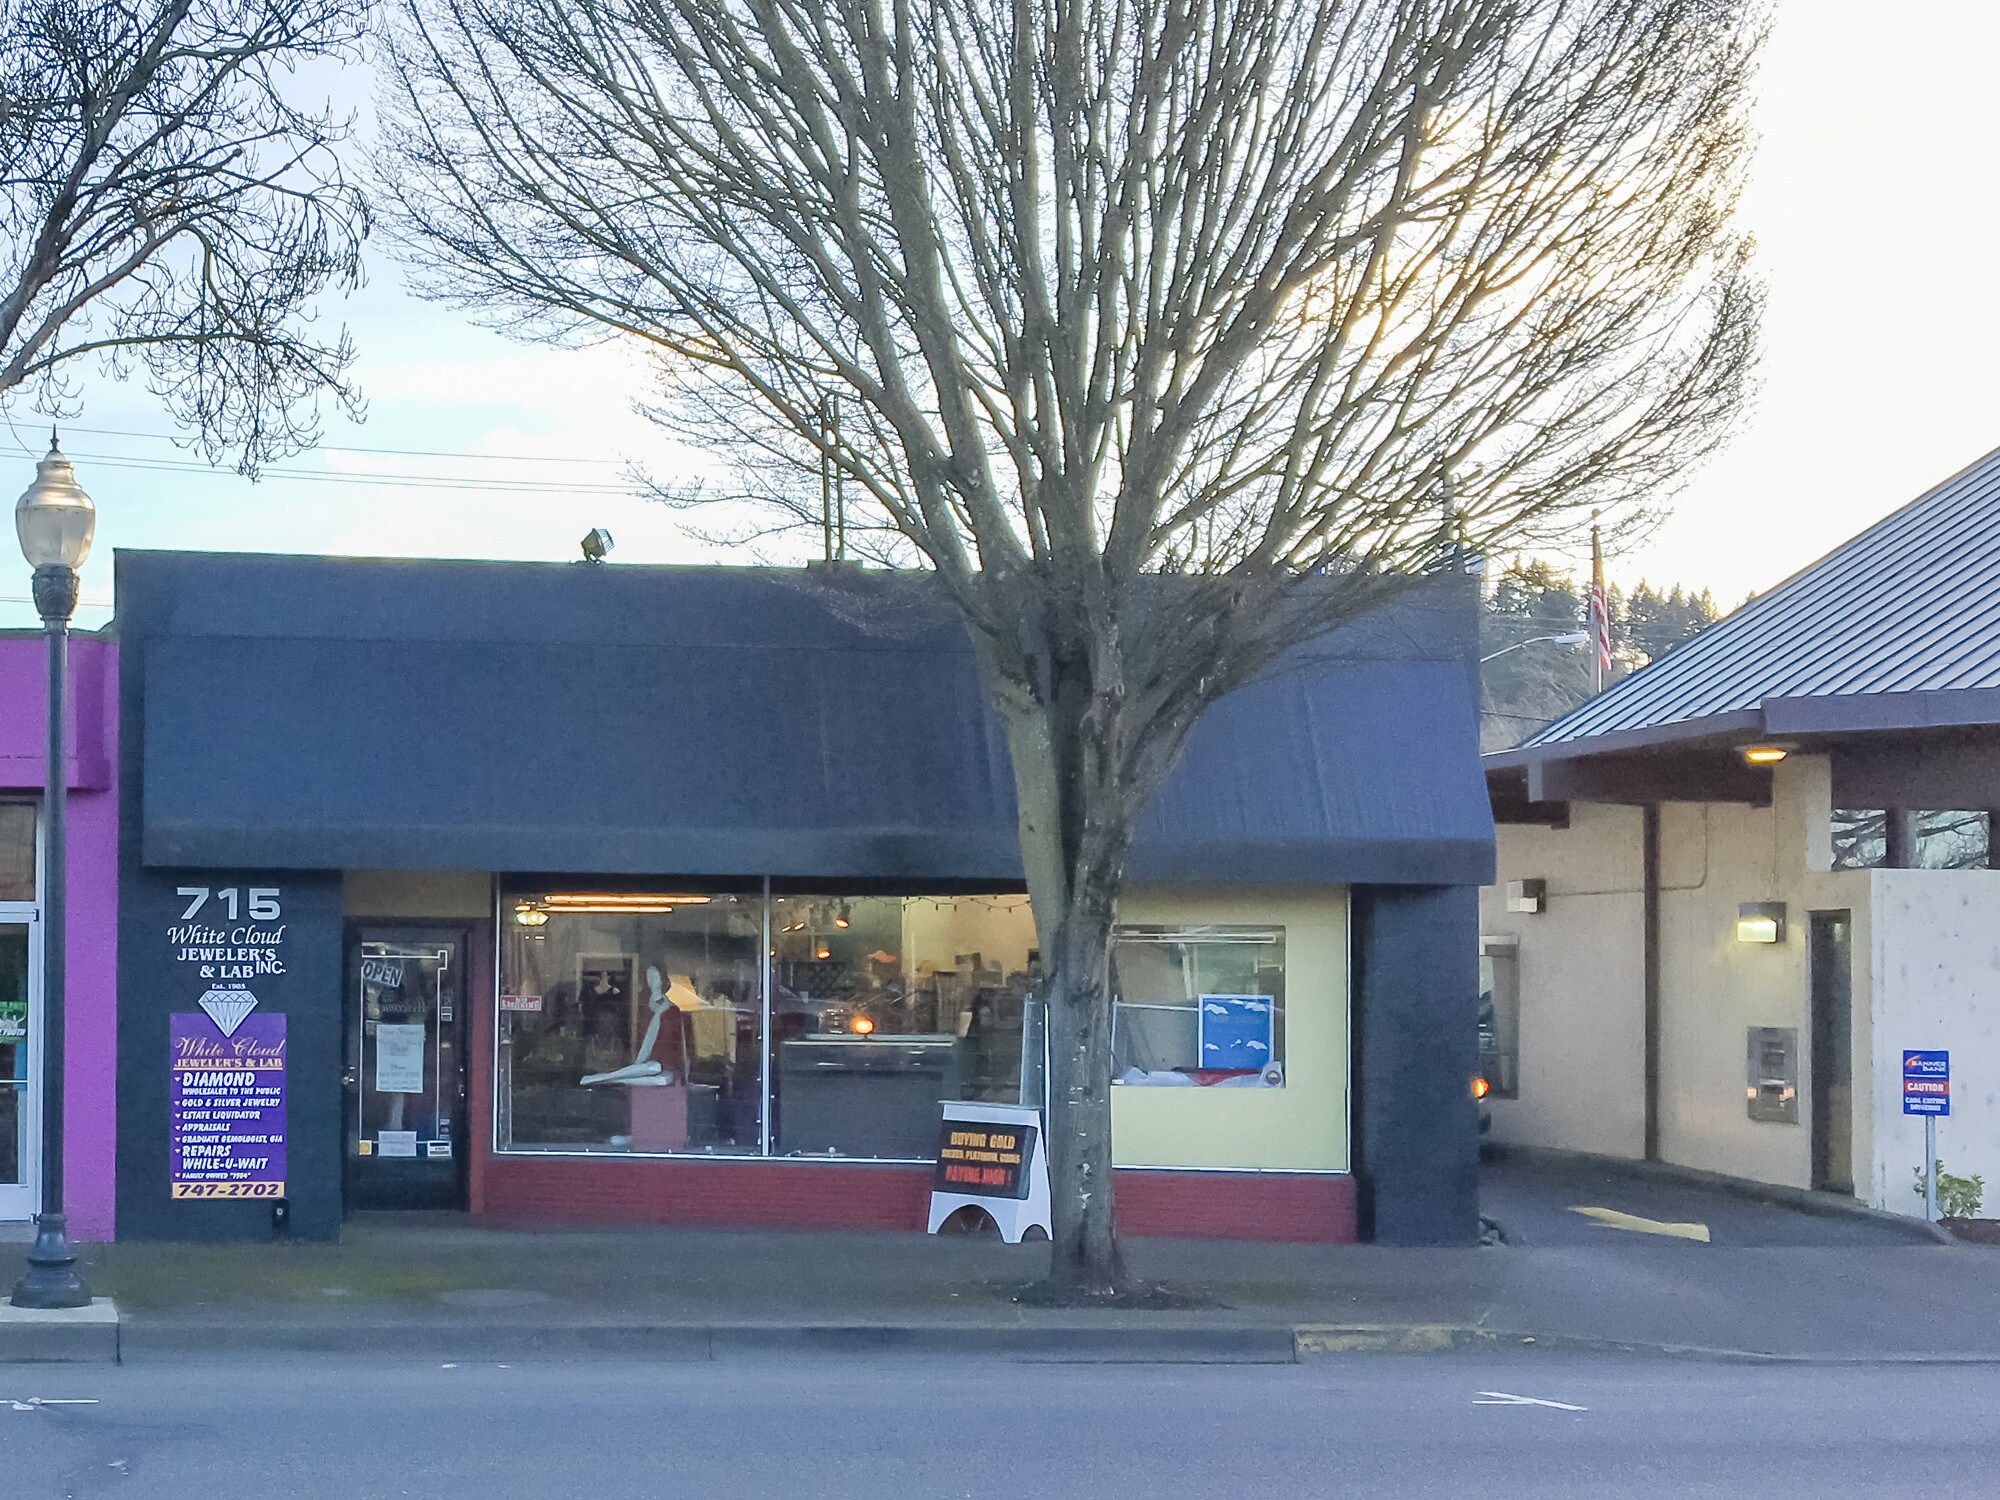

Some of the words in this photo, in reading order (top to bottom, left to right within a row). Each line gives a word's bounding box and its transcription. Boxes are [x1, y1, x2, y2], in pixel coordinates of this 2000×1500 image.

[177, 887, 280, 920] 715
[167, 924, 226, 944] White
[231, 924, 286, 945] Cloud
[177, 948, 276, 961] JEWELER'S
[200, 965, 216, 978] &
[220, 965, 254, 978] LAB
[256, 961, 286, 974] INC.
[363, 960, 400, 985] OPEN
[175, 1037, 224, 1057] White
[231, 1037, 286, 1057] Cloud
[174, 1058, 242, 1067] JEWELER'S
[245, 1059, 255, 1067] &
[260, 1058, 282, 1067] LAB
[182, 1072, 256, 1087] DIAMOND
[182, 1087, 228, 1096] WHOLESALER
[229, 1088, 238, 1096] TO
[240, 1088, 254, 1096] THE
[256, 1087, 281, 1095] PUBLIC
[1907, 1082, 1944, 1092] CAUTION
[182, 1098, 204, 1108] GOLD
[205, 1098, 212, 1108] &
[213, 1098, 241, 1108] SILVER
[243, 1098, 281, 1108] JEWELRY
[182, 1111, 211, 1120] ESTATE
[213, 1111, 261, 1120] LIQUIDATOR
[182, 1123, 231, 1132] APPRAISALS
[182, 1135, 219, 1143] GRADUATE
[269, 1135, 283, 1143] GIA
[951, 1132, 987, 1147] BUYING
[990, 1134, 1016, 1149] GOLD
[182, 1145, 232, 1157] REPAIRS
[182, 1158, 269, 1170] WHILE-U-WAIT
[178, 1184, 279, 1197] 747-2702
